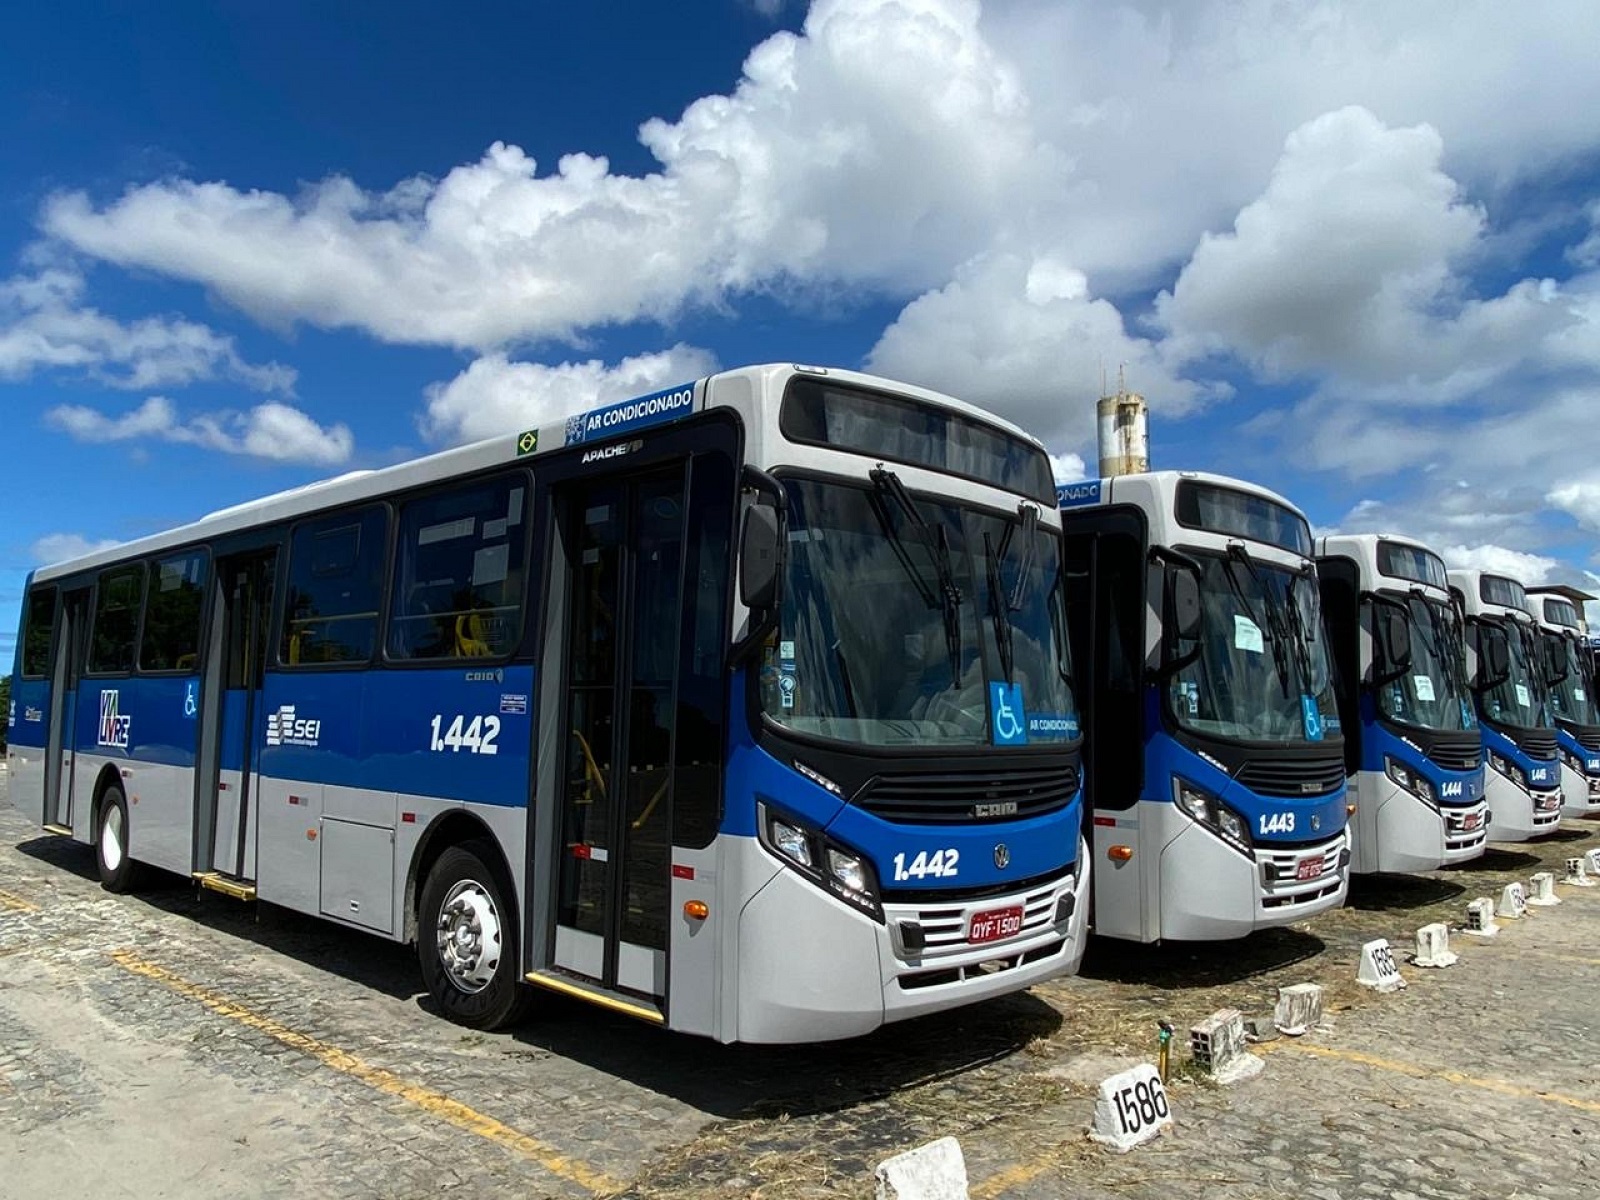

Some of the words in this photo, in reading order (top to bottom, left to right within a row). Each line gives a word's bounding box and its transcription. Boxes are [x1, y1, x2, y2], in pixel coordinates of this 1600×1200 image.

[587, 415, 602, 431] AR
[603, 390, 692, 427] CONDICIONADO
[581, 443, 628, 464] APACHE
[430, 714, 501, 755] 1.442
[1259, 811, 1295, 835] 1.443
[893, 848, 960, 881] 1.442
[972, 915, 1021, 940] OYF-1500
[1112, 1076, 1168, 1134] 1586
